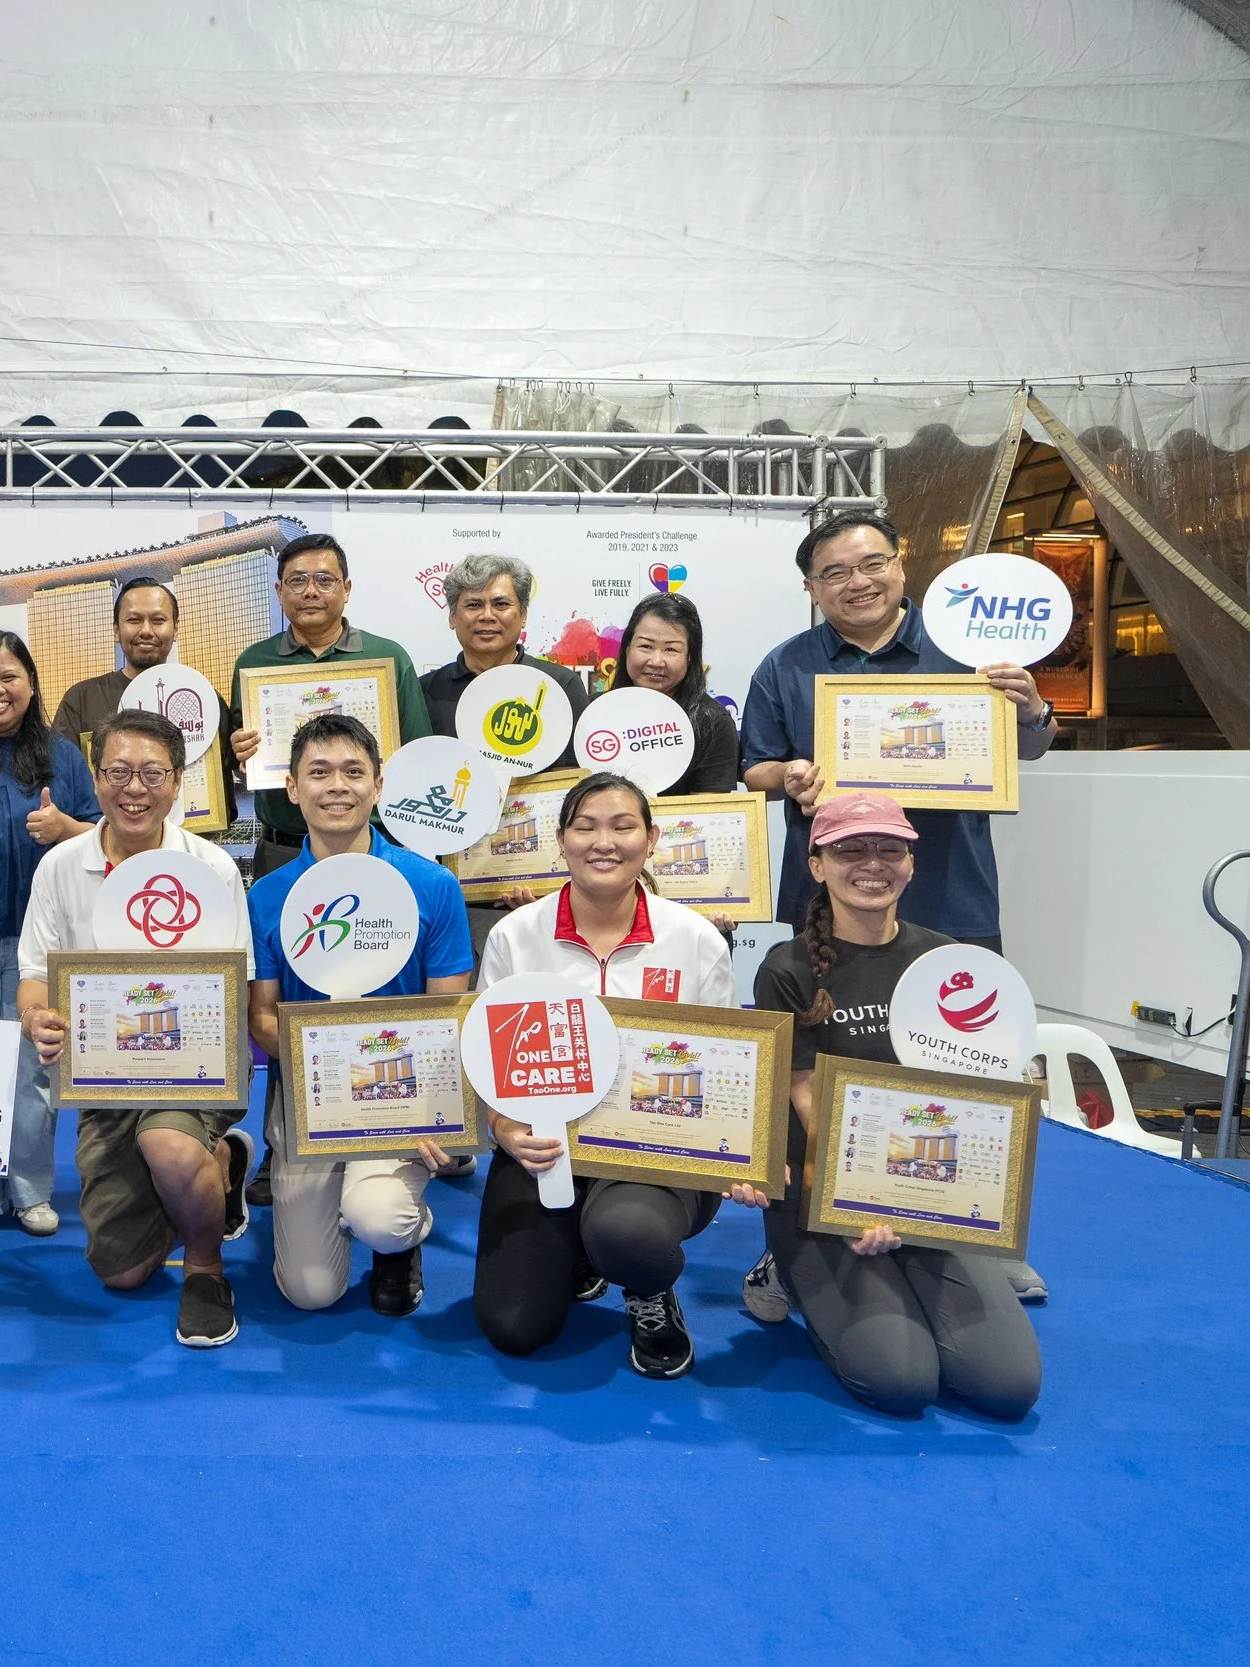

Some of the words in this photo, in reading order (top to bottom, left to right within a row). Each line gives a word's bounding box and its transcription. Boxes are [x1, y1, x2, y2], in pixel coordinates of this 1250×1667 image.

[452, 529, 490, 538] Supported
[492, 529, 501, 538] by
[586, 531, 618, 539] Awarded
[620, 531, 660, 539] President's
[662, 531, 698, 541] Challenge
[608, 543, 628, 552] 2019,
[631, 543, 650, 551] 2021
[652, 543, 658, 551] &
[659, 543, 679, 551] 2023
[592, 579, 606, 588] GIVE
[594, 589, 608, 597] LIVE
[970, 596, 1051, 621] NHG
[966, 620, 1047, 641] Health
[591, 738, 616, 753] SG
[629, 735, 683, 752] OFFICE
[479, 750, 502, 761] ASJID
[503, 756, 534, 769] AN-NUR
[384, 809, 417, 823] DARUL
[419, 818, 465, 835] MAKMUR
[355, 918, 393, 928] Health
[354, 929, 411, 940] Promotion
[354, 940, 389, 950] Board
[733, 939, 756, 948] g.sg
[849, 1024, 891, 1036] SINGA
[908, 1030, 957, 1054] YOUTH
[961, 1048, 1009, 1069] CORPS
[516, 1050, 550, 1064] ONE
[921, 1050, 988, 1075] SINGAPORE
[510, 1066, 576, 1087] CARE
[528, 1086, 577, 1095] TaoOne.org
